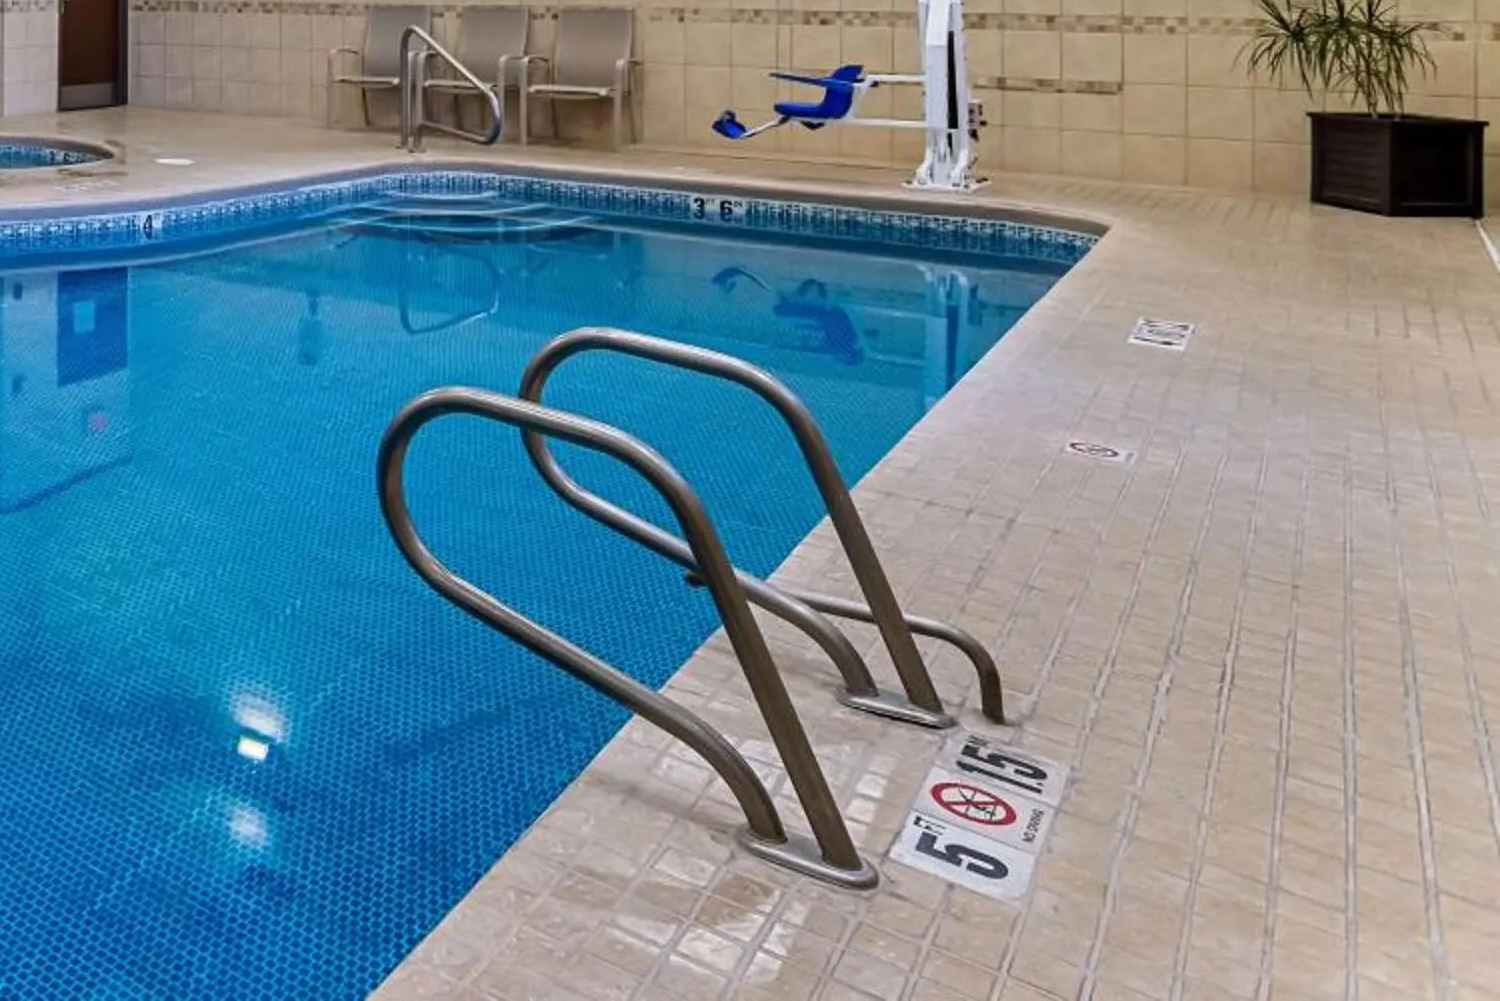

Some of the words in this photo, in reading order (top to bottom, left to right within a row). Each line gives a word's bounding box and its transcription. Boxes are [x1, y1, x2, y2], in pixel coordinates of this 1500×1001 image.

[143, 214, 153, 230] 4
[956, 744, 1047, 794] 1.5
[915, 831, 1008, 879] 5
